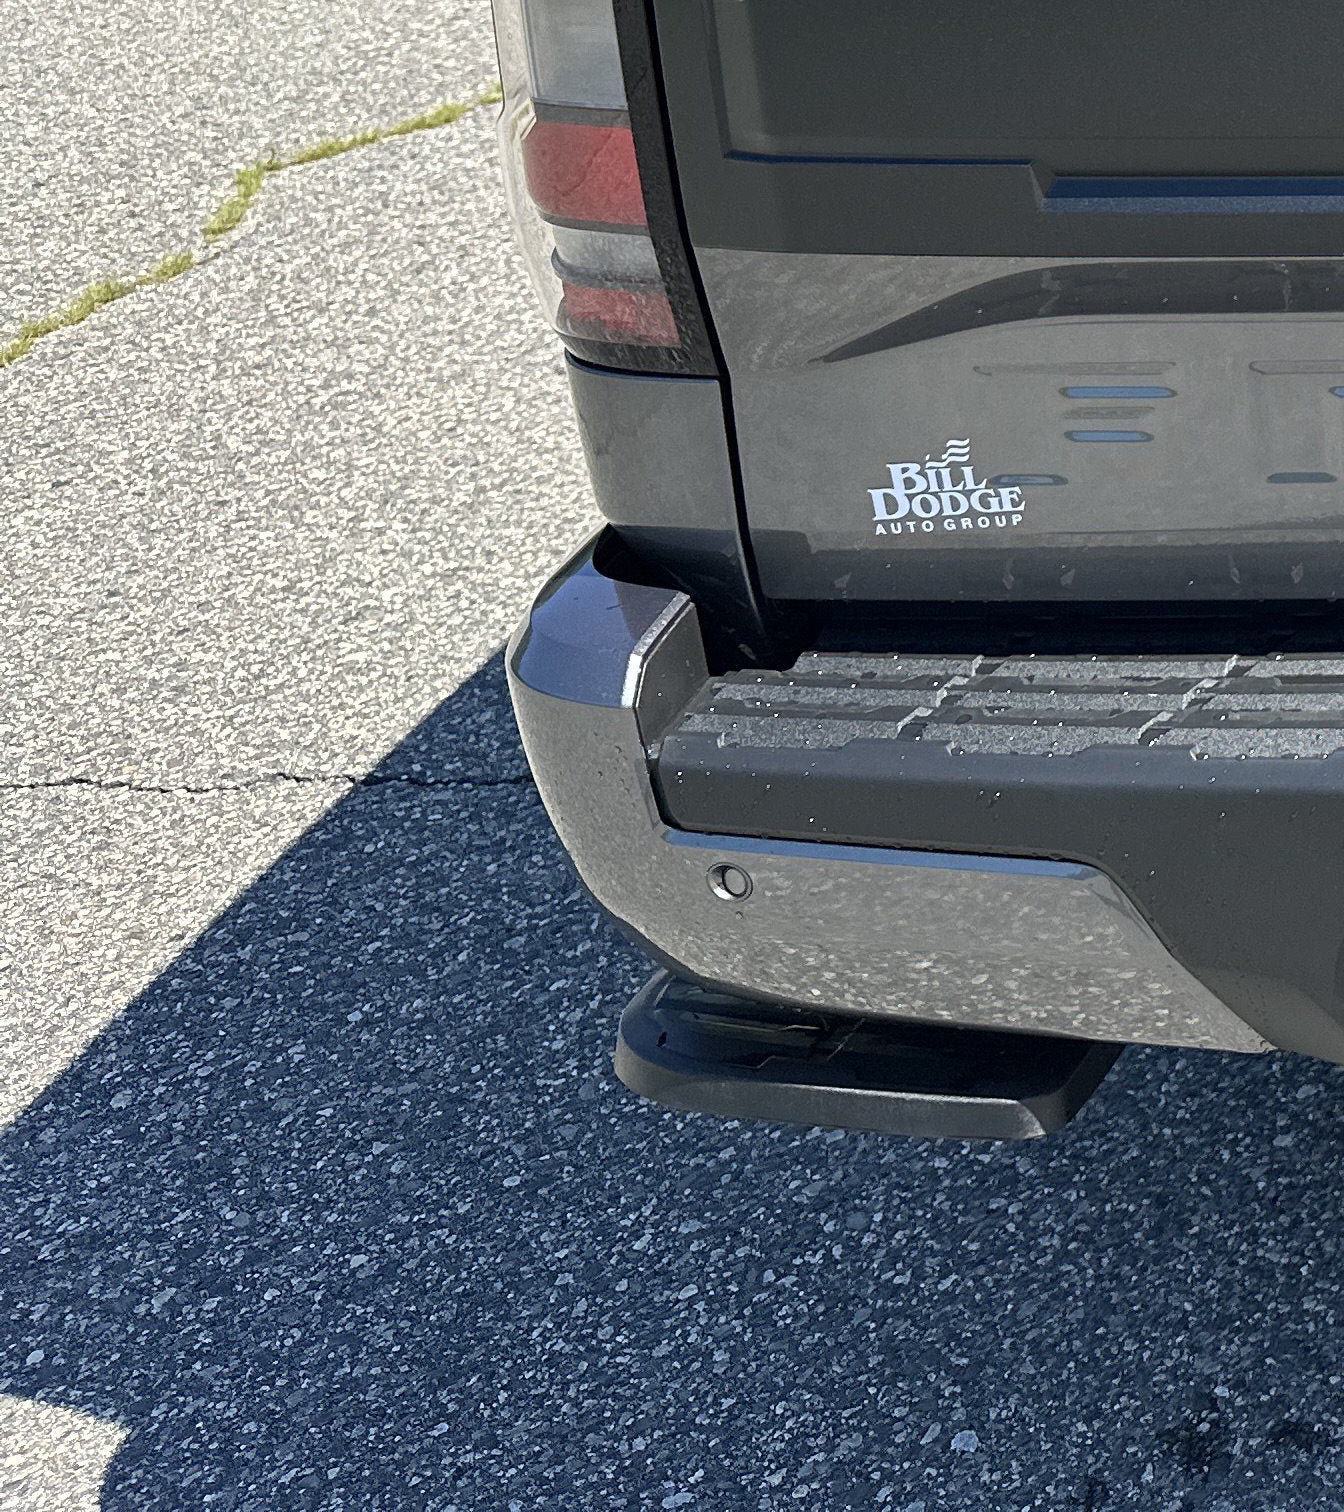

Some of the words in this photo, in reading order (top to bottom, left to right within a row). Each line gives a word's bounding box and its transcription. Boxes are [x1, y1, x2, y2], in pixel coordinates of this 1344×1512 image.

[886, 462, 988, 494] BILL
[867, 485, 1026, 521] DODGE
[875, 520, 935, 536] AUTO
[943, 513, 1023, 531] GROUP
